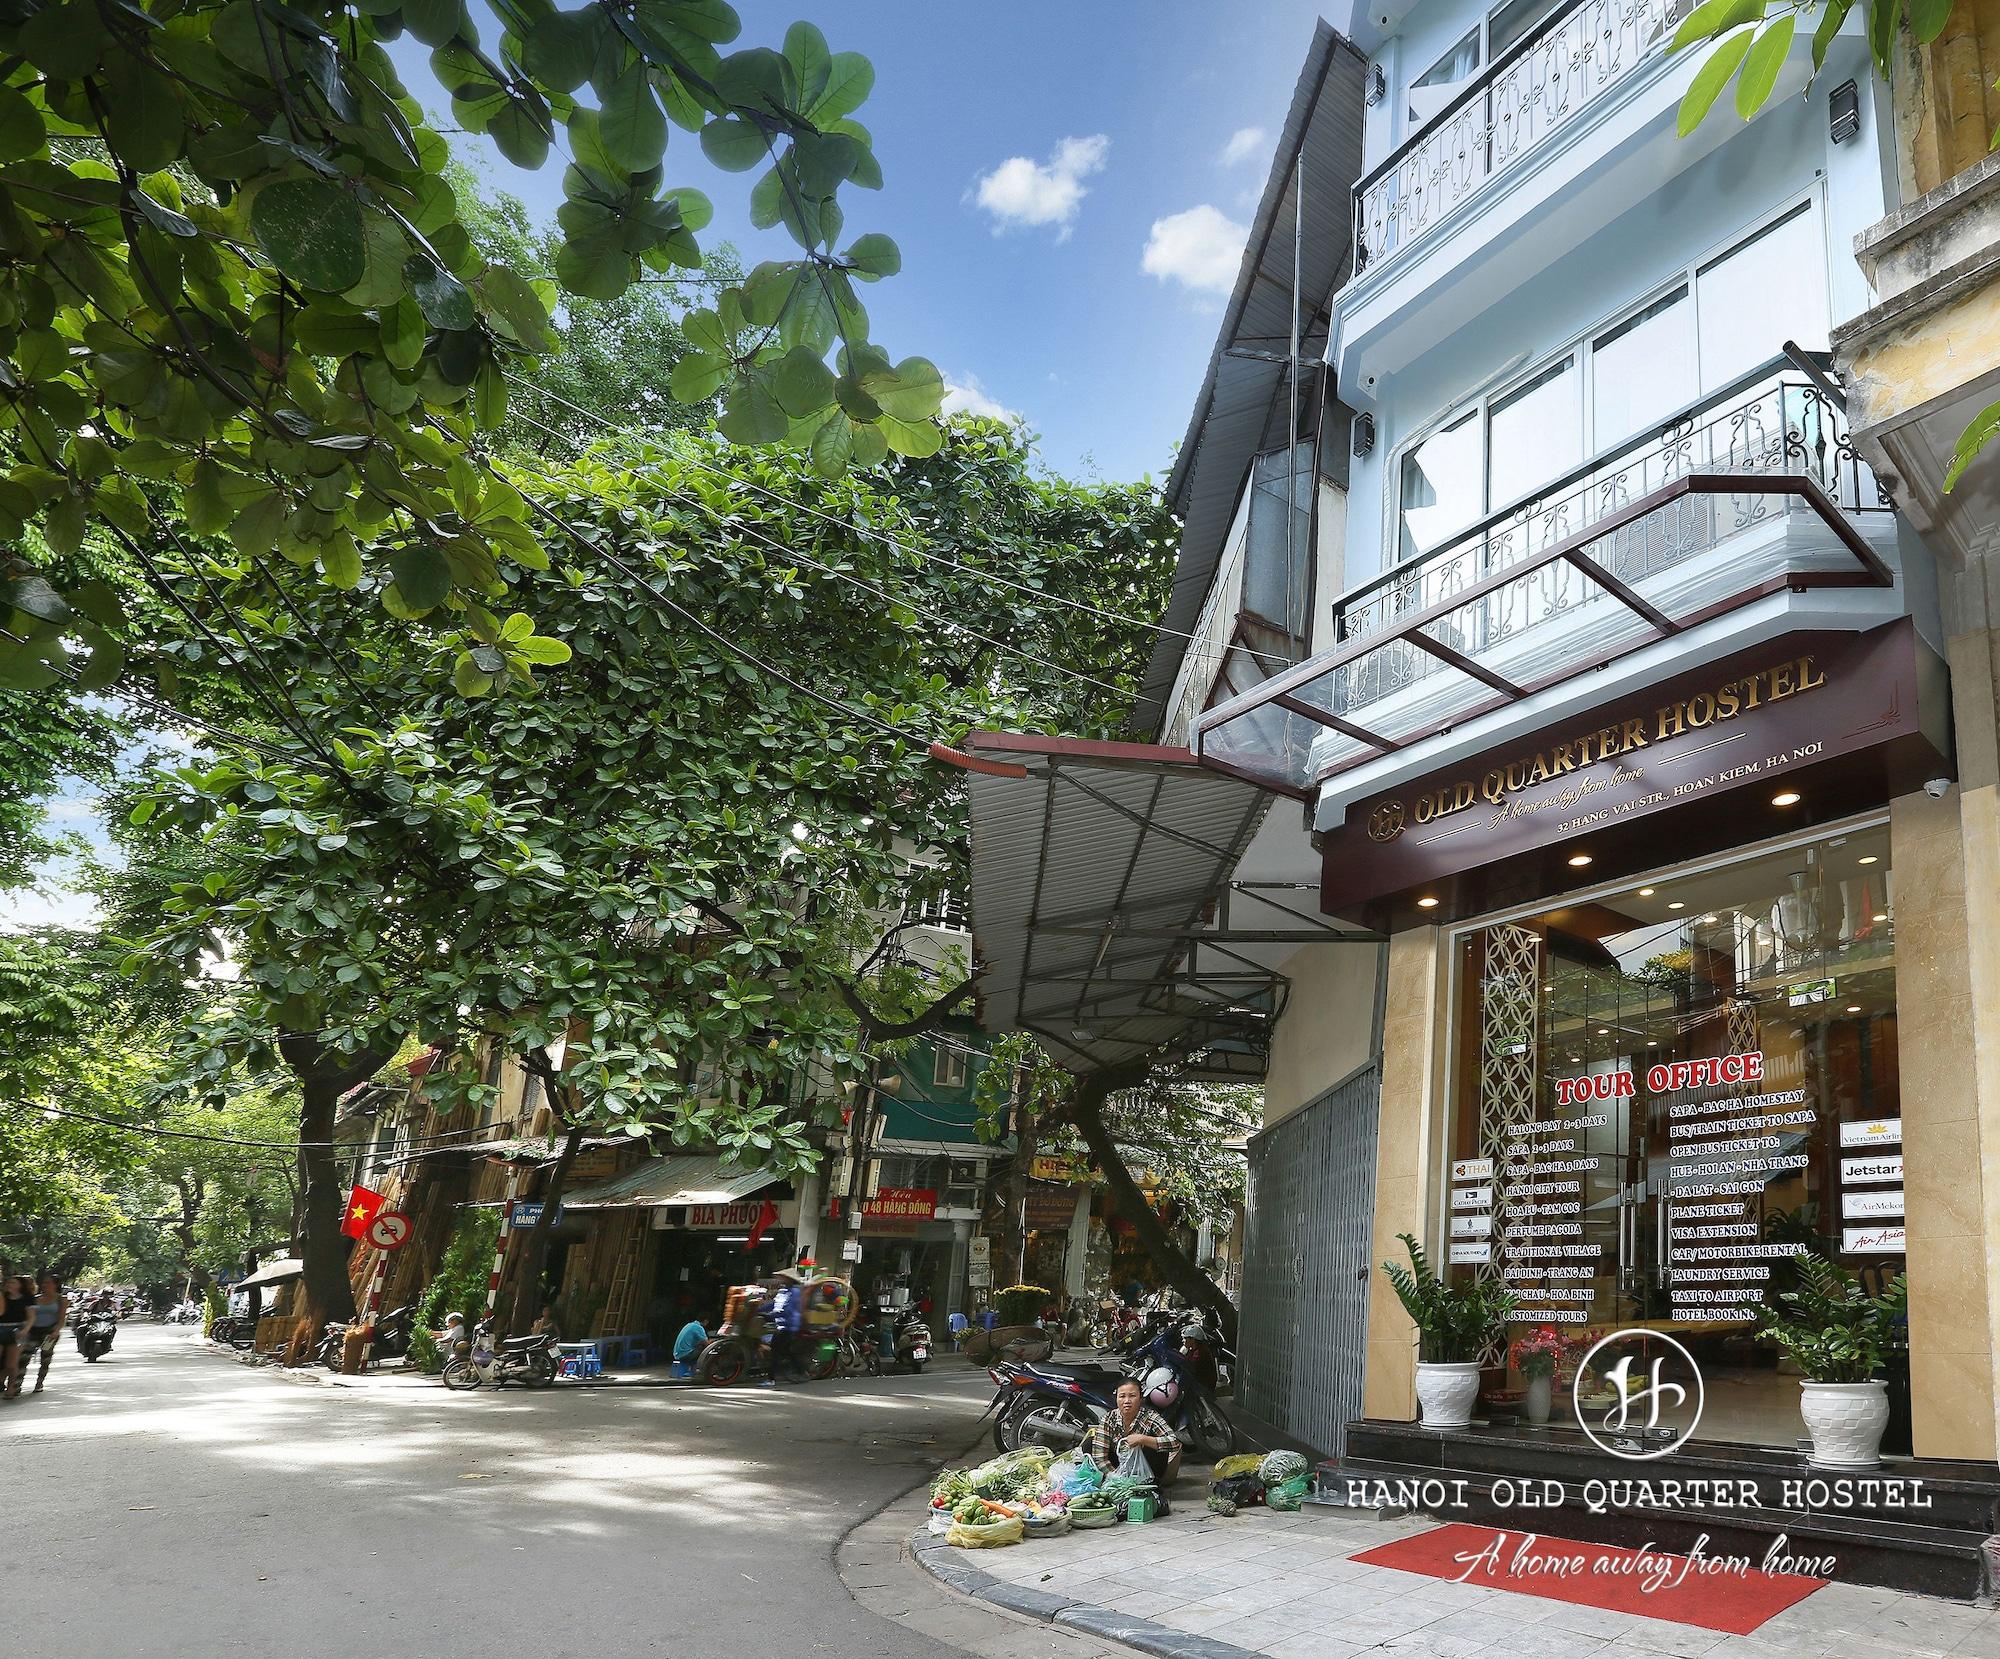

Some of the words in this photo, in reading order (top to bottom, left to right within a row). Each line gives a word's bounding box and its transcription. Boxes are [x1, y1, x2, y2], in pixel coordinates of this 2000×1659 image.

[1414, 779, 1477, 824] OLD
[1482, 718, 1648, 805] QUARTER
[1655, 655, 1827, 741] HOSTEL
[1557, 821, 1569, 834] 32
[1571, 808, 1610, 830] HANG
[1612, 799, 1637, 816] VAI
[1673, 774, 1714, 797] HOAN
[1718, 761, 1762, 782] KIEM,
[1765, 753, 1789, 768] HA
[1792, 741, 1824, 760] NOI
[1487, 802, 1509, 829] A
[1510, 797, 1541, 820] home
[1540, 785, 1575, 811] away
[1571, 775, 1607, 804] from
[1608, 765, 1644, 788] home
[1555, 1071, 1635, 1106] TOUR
[1647, 1050, 1764, 1094] OFFICE
[1670, 1104, 1697, 1118] SAPA
[1703, 1101, 1726, 1114] BAC
[1726, 1098, 1742, 1111] HA
[1745, 1090, 1805, 1108] HOMESTAY
[1507, 1121, 1541, 1136] HALONG
[1543, 1120, 1561, 1131] BAY
[1582, 1115, 1608, 1127] DAYS
[1670, 1121, 1727, 1138] BUS/TRAIN
[1727, 1115, 1766, 1129] TICKET
[1767, 1114, 1784, 1126] TO
[1784, 1110, 1816, 1124] SAPA
[1670, 1143, 1698, 1158] OPEN
[1699, 1141, 1720, 1155] BUS
[1721, 1138, 1760, 1153] TICKET
[1761, 1136, 1780, 1149] TO:
[1844, 1135, 1879, 1143] Vietnam
[1507, 1143, 1530, 1156] SAPA
[1549, 1139, 1574, 1151] DAYS
[1467, 1165, 1490, 1174] THAI
[1506, 1164, 1530, 1177] SAPA
[1534, 1162, 1552, 1175] BAC
[1552, 1161, 1566, 1174] HA
[1573, 1158, 1599, 1171] DAYS
[1670, 1165, 1694, 1178] HUE
[1698, 1163, 1718, 1176] HOI
[1718, 1162, 1736, 1174] AN
[1742, 1158, 1767, 1172] NHA
[1769, 1154, 1809, 1169] TRANG
[1846, 1165, 1897, 1176] Jetstar
[1506, 1184, 1533, 1197] HANOI
[1534, 1183, 1555, 1195] CITY
[1556, 1181, 1580, 1193] TOUR
[1676, 1185, 1694, 1198] DA
[1694, 1183, 1714, 1197] LAT
[1719, 1182, 1739, 1194] SAI
[1740, 1180, 1765, 1193] GON
[691, 1205, 715, 1225] BIA
[871, 1201, 881, 1213] 48
[1506, 1205, 1524, 1217] HOA
[1525, 1204, 1538, 1216] LU
[1542, 1203, 1561, 1215] TAM
[1562, 1202, 1580, 1214] COC
[1670, 1205, 1705, 1219] PLANE
[1706, 1203, 1744, 1216] TICKET
[1506, 1225, 1545, 1237] PERFUME
[1545, 1223, 1581, 1236] PAGODA
[1671, 1227, 1696, 1240] VISA
[1696, 1224, 1758, 1238] EXTENSION
[1852, 1236, 1876, 1250] Air
[1505, 1245, 1562, 1259] TRADITIONAL
[1563, 1244, 1601, 1257] VILLAGE
[1671, 1248, 1697, 1262] CAR/
[1698, 1245, 1762, 1260] MOTORBIKE
[1762, 1243, 1808, 1257] RENTAL
[1504, 1267, 1521, 1279] BAI
[1521, 1267, 1544, 1279] DINH
[1548, 1267, 1579, 1279] TRANG
[1579, 1266, 1594, 1278] AN
[1671, 1268, 1722, 1281] LAUNDRY
[1722, 1267, 1770, 1280] SERVICE
[1521, 1289, 1546, 1300] CHAU
[1551, 1289, 1571, 1300] HOA
[1571, 1289, 1595, 1300] BINH
[1671, 1290, 1698, 1303] TAXI
[1698, 1290, 1714, 1302] TO
[1714, 1289, 1763, 1302] AIRPORT
[1503, 1310, 1556, 1322] CUSTOMIZED
[1557, 1311, 1588, 1322] TOURS
[1672, 1308, 1706, 1320] HOTEL
